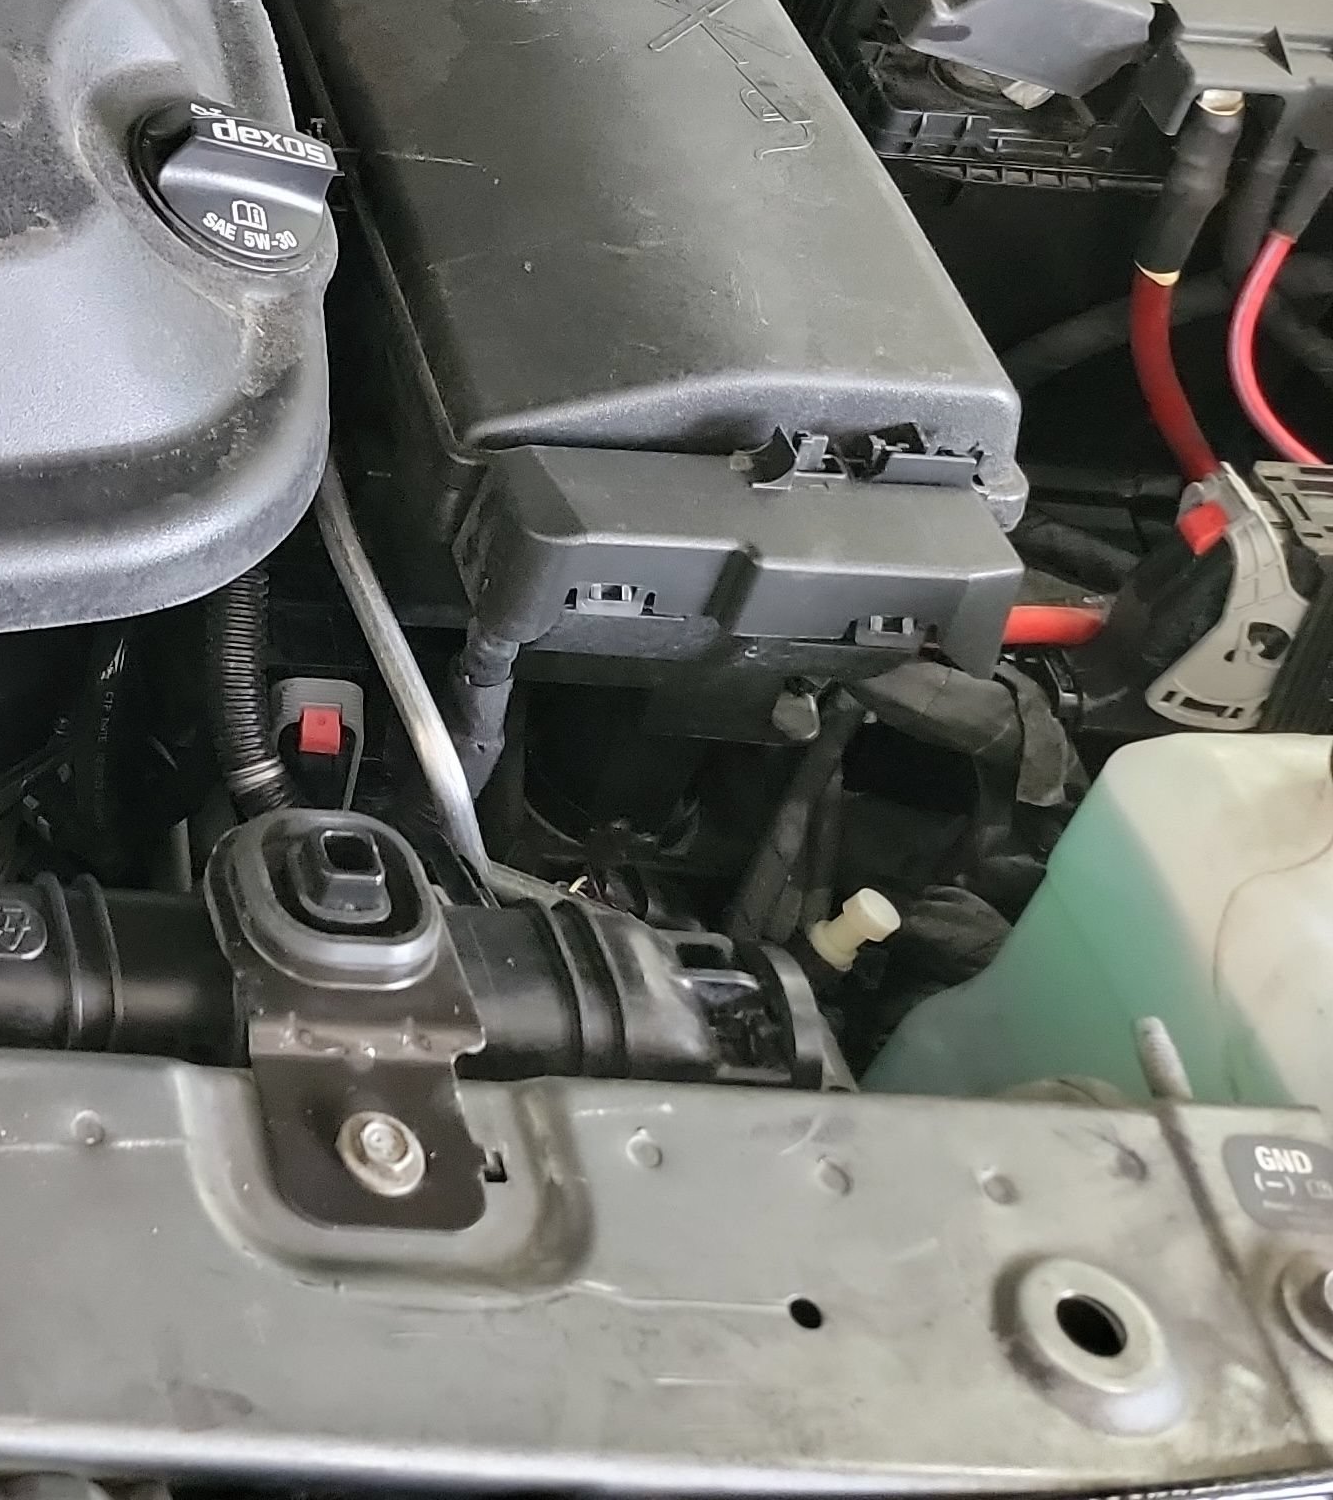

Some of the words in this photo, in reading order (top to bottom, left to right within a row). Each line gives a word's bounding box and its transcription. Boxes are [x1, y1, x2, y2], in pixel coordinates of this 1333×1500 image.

[211, 118, 328, 165] dexos
[201, 211, 238, 241] SAE
[243, 230, 298, 251] 5W-30
[1253, 1145, 1313, 1174] GND
